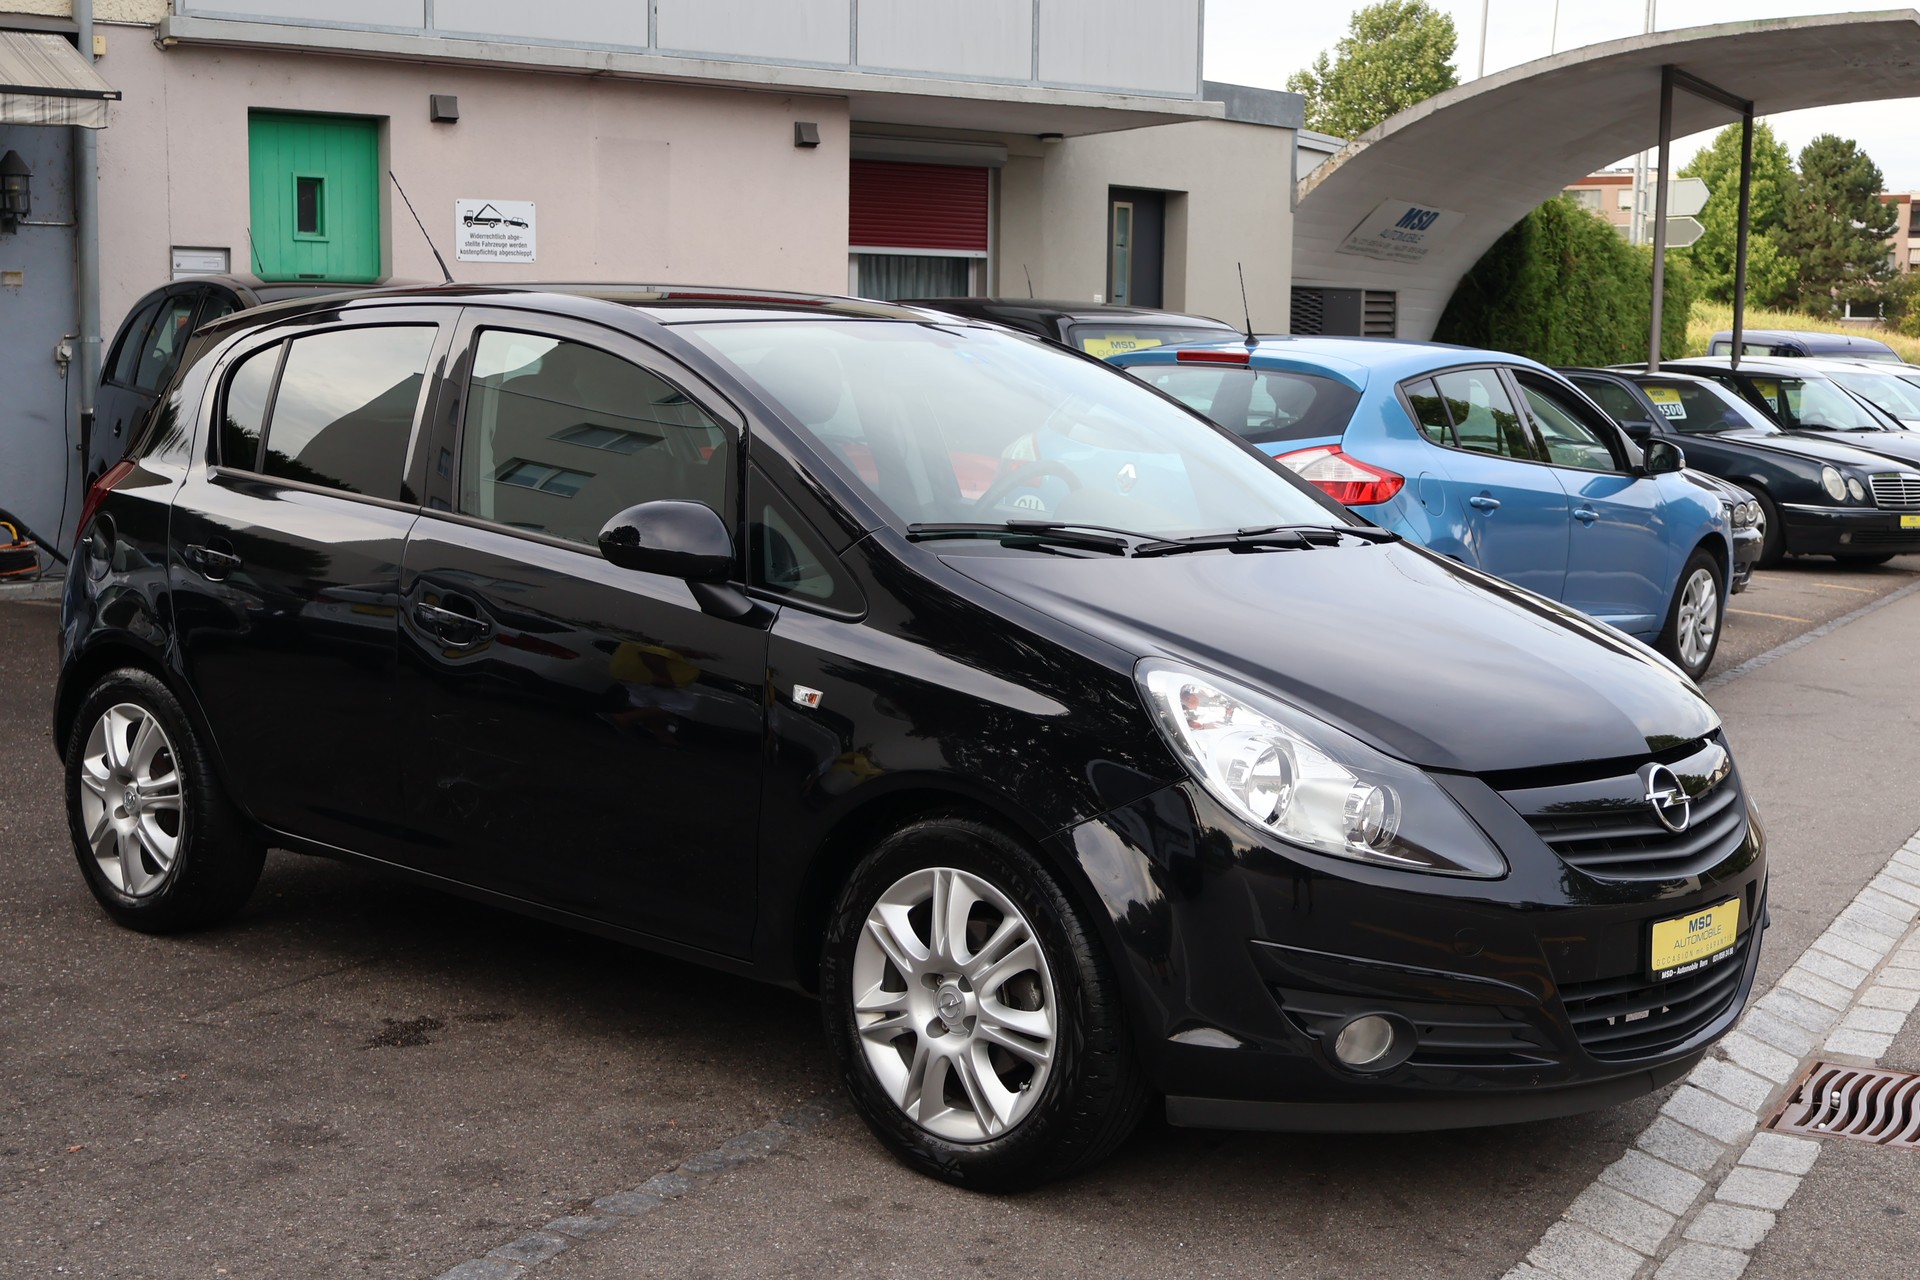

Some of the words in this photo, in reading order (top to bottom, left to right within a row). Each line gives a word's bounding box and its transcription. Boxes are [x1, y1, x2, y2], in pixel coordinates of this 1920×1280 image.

[1395, 208, 1439, 230] MSD
[469, 232, 506, 240] Widerrechtlich
[460, 248, 498, 256] kostenpflichtig
[1110, 341, 1136, 349] MSD
[1688, 913, 1712, 934] MSD
[1674, 924, 1722, 950] AUTOMOBILE
[1656, 950, 1693, 967] OCCASION
[1661, 969, 1674, 979] MSD
